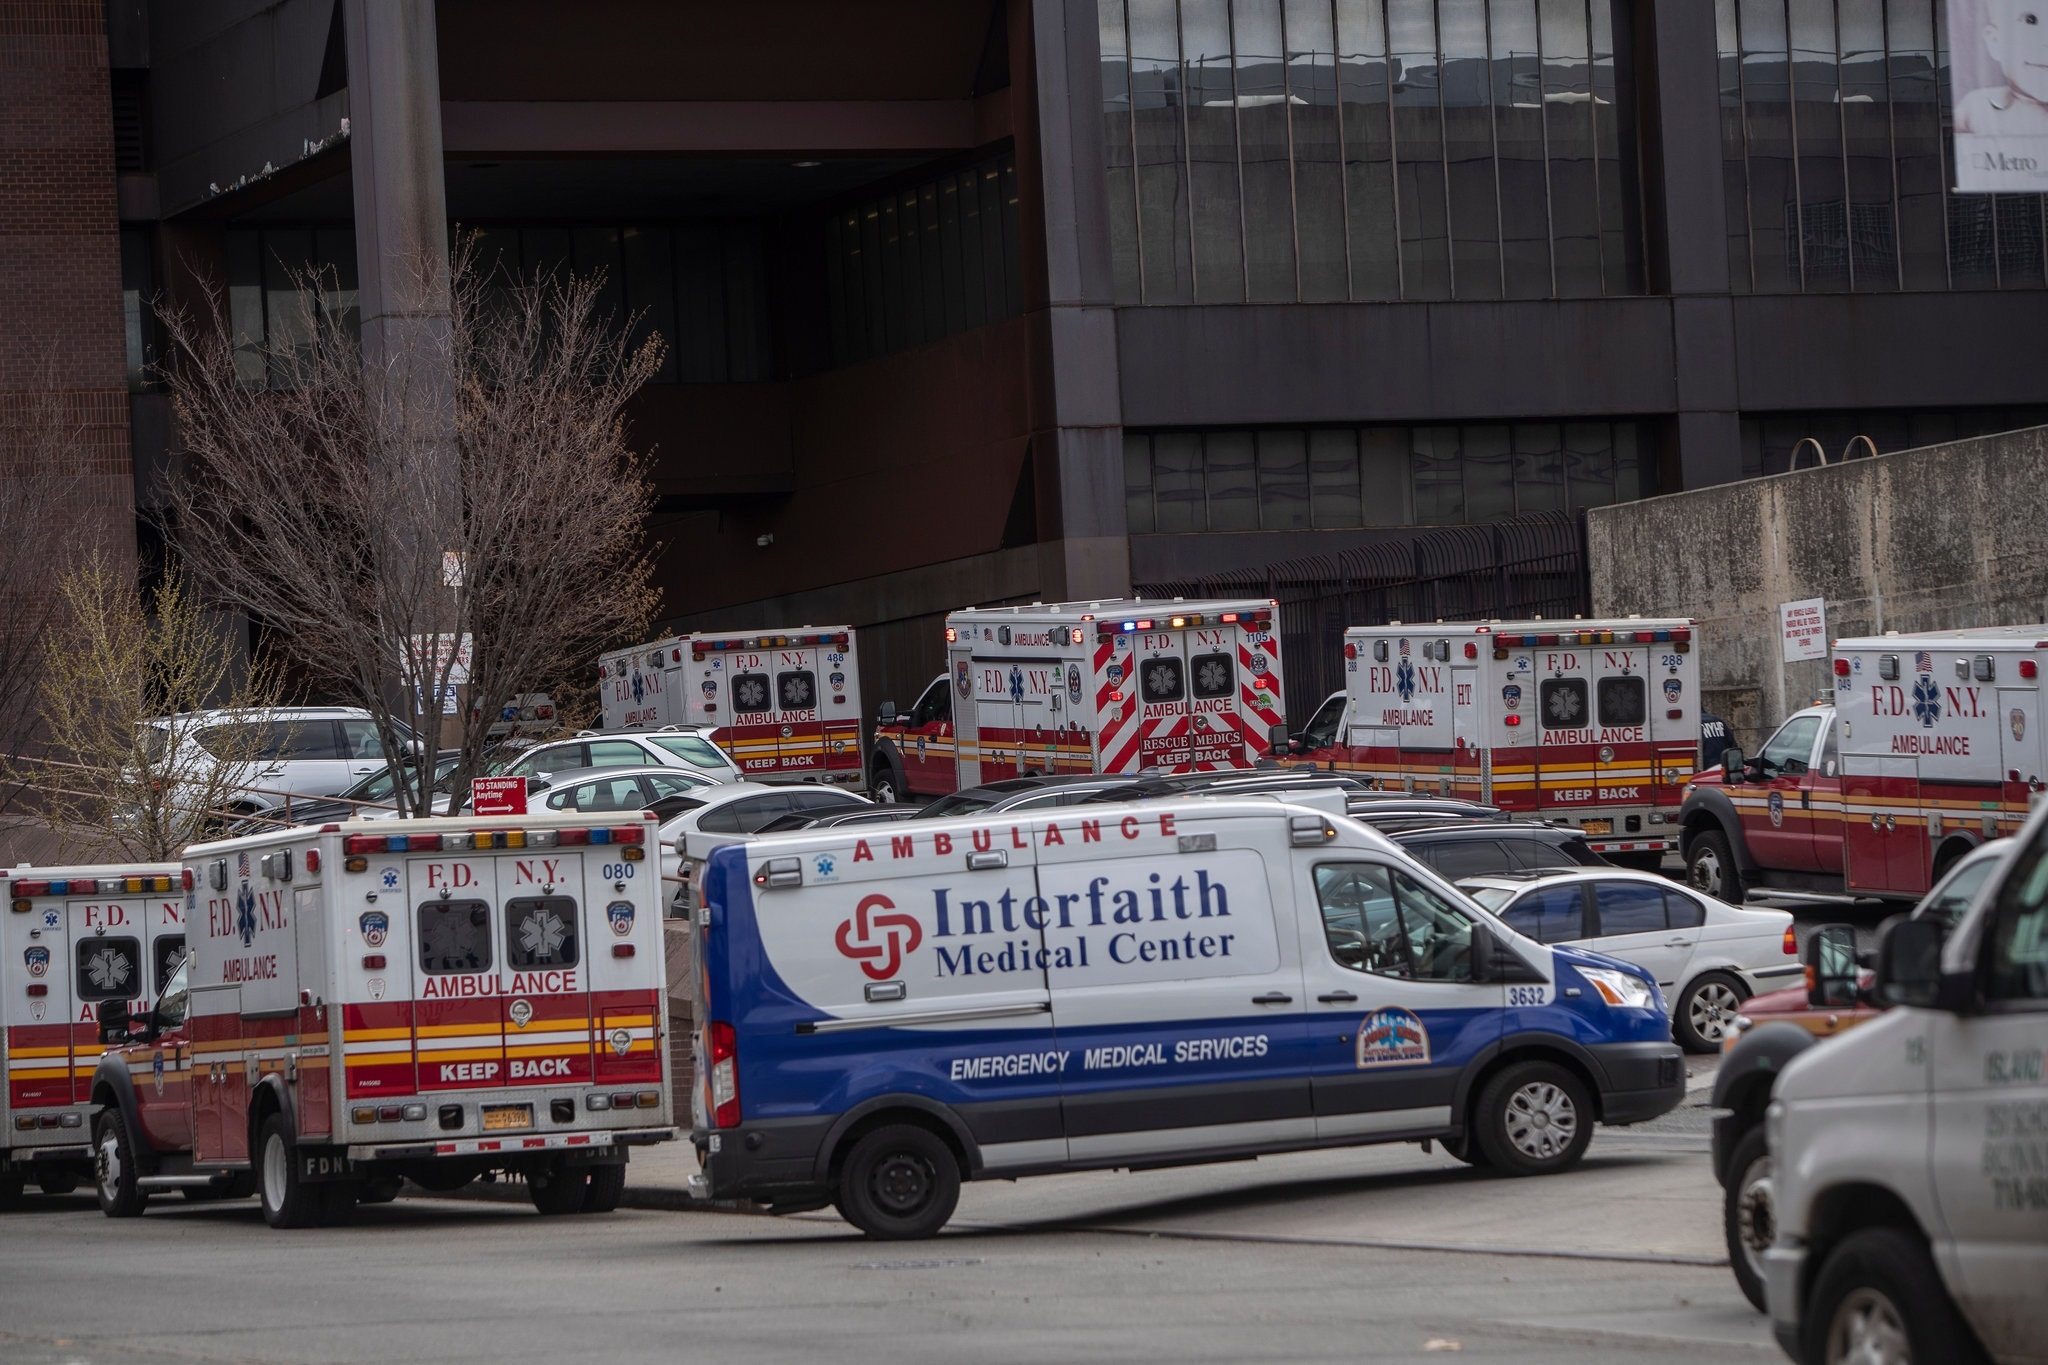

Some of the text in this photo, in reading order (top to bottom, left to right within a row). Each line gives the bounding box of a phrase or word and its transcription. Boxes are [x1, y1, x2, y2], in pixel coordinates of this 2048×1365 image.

[1014, 633, 1050, 647] AMBULANCE
[1144, 629, 1227, 650] F.D. N.Y.
[1246, 632, 1268, 643] 1105
[735, 652, 808, 669] F.D. N.Y.
[1547, 651, 1637, 670] F.D. N.Y.
[1662, 654, 1683, 666] 288
[615, 672, 662, 702] F.D. N.Y.
[984, 669, 1006, 693] F.D.
[1028, 670, 1051, 694] N.Y.
[1370, 666, 1444, 693] F.D. N.Y.
[1457, 684, 1472, 705] HT
[1871, 685, 1986, 718] F.D. N.Y.
[625, 707, 657, 723] AMBULANCE
[735, 709, 816, 726] AMBULANCE
[1143, 698, 1233, 718] AMBULANCE
[1383, 709, 1434, 726] AMBULANCE
[1143, 732, 1241, 750] RESCUE MEDICS
[1542, 727, 1644, 745] AMBULANCE
[1891, 734, 1971, 756] AMBULANCE
[745, 756, 815, 769] KEEP BACK
[1156, 749, 1231, 766] KEEP BACK
[475, 780, 518, 790] NO STANDING
[1554, 787, 1639, 802] KEEP BACK
[476, 791, 503, 801] Anytime
[852, 812, 1178, 864] AMBULANCE
[427, 859, 565, 888] F.D. N.Y.
[603, 863, 634, 880] 080
[209, 889, 287, 937] F.D. N.Y.
[931, 869, 1233, 938] Interfaith
[85, 902, 186, 927] F.D. N.
[932, 930, 1235, 978] Medical Center
[223, 955, 277, 983] AMBULANCE
[422, 970, 578, 999] AMBULANCE
[1509, 986, 1545, 1007] 3632
[950, 1034, 1269, 1081] EMERGENCY MEDICAL SERVICES
[440, 1058, 571, 1082] KEEP BACK
[306, 1157, 355, 1175] FDNY
